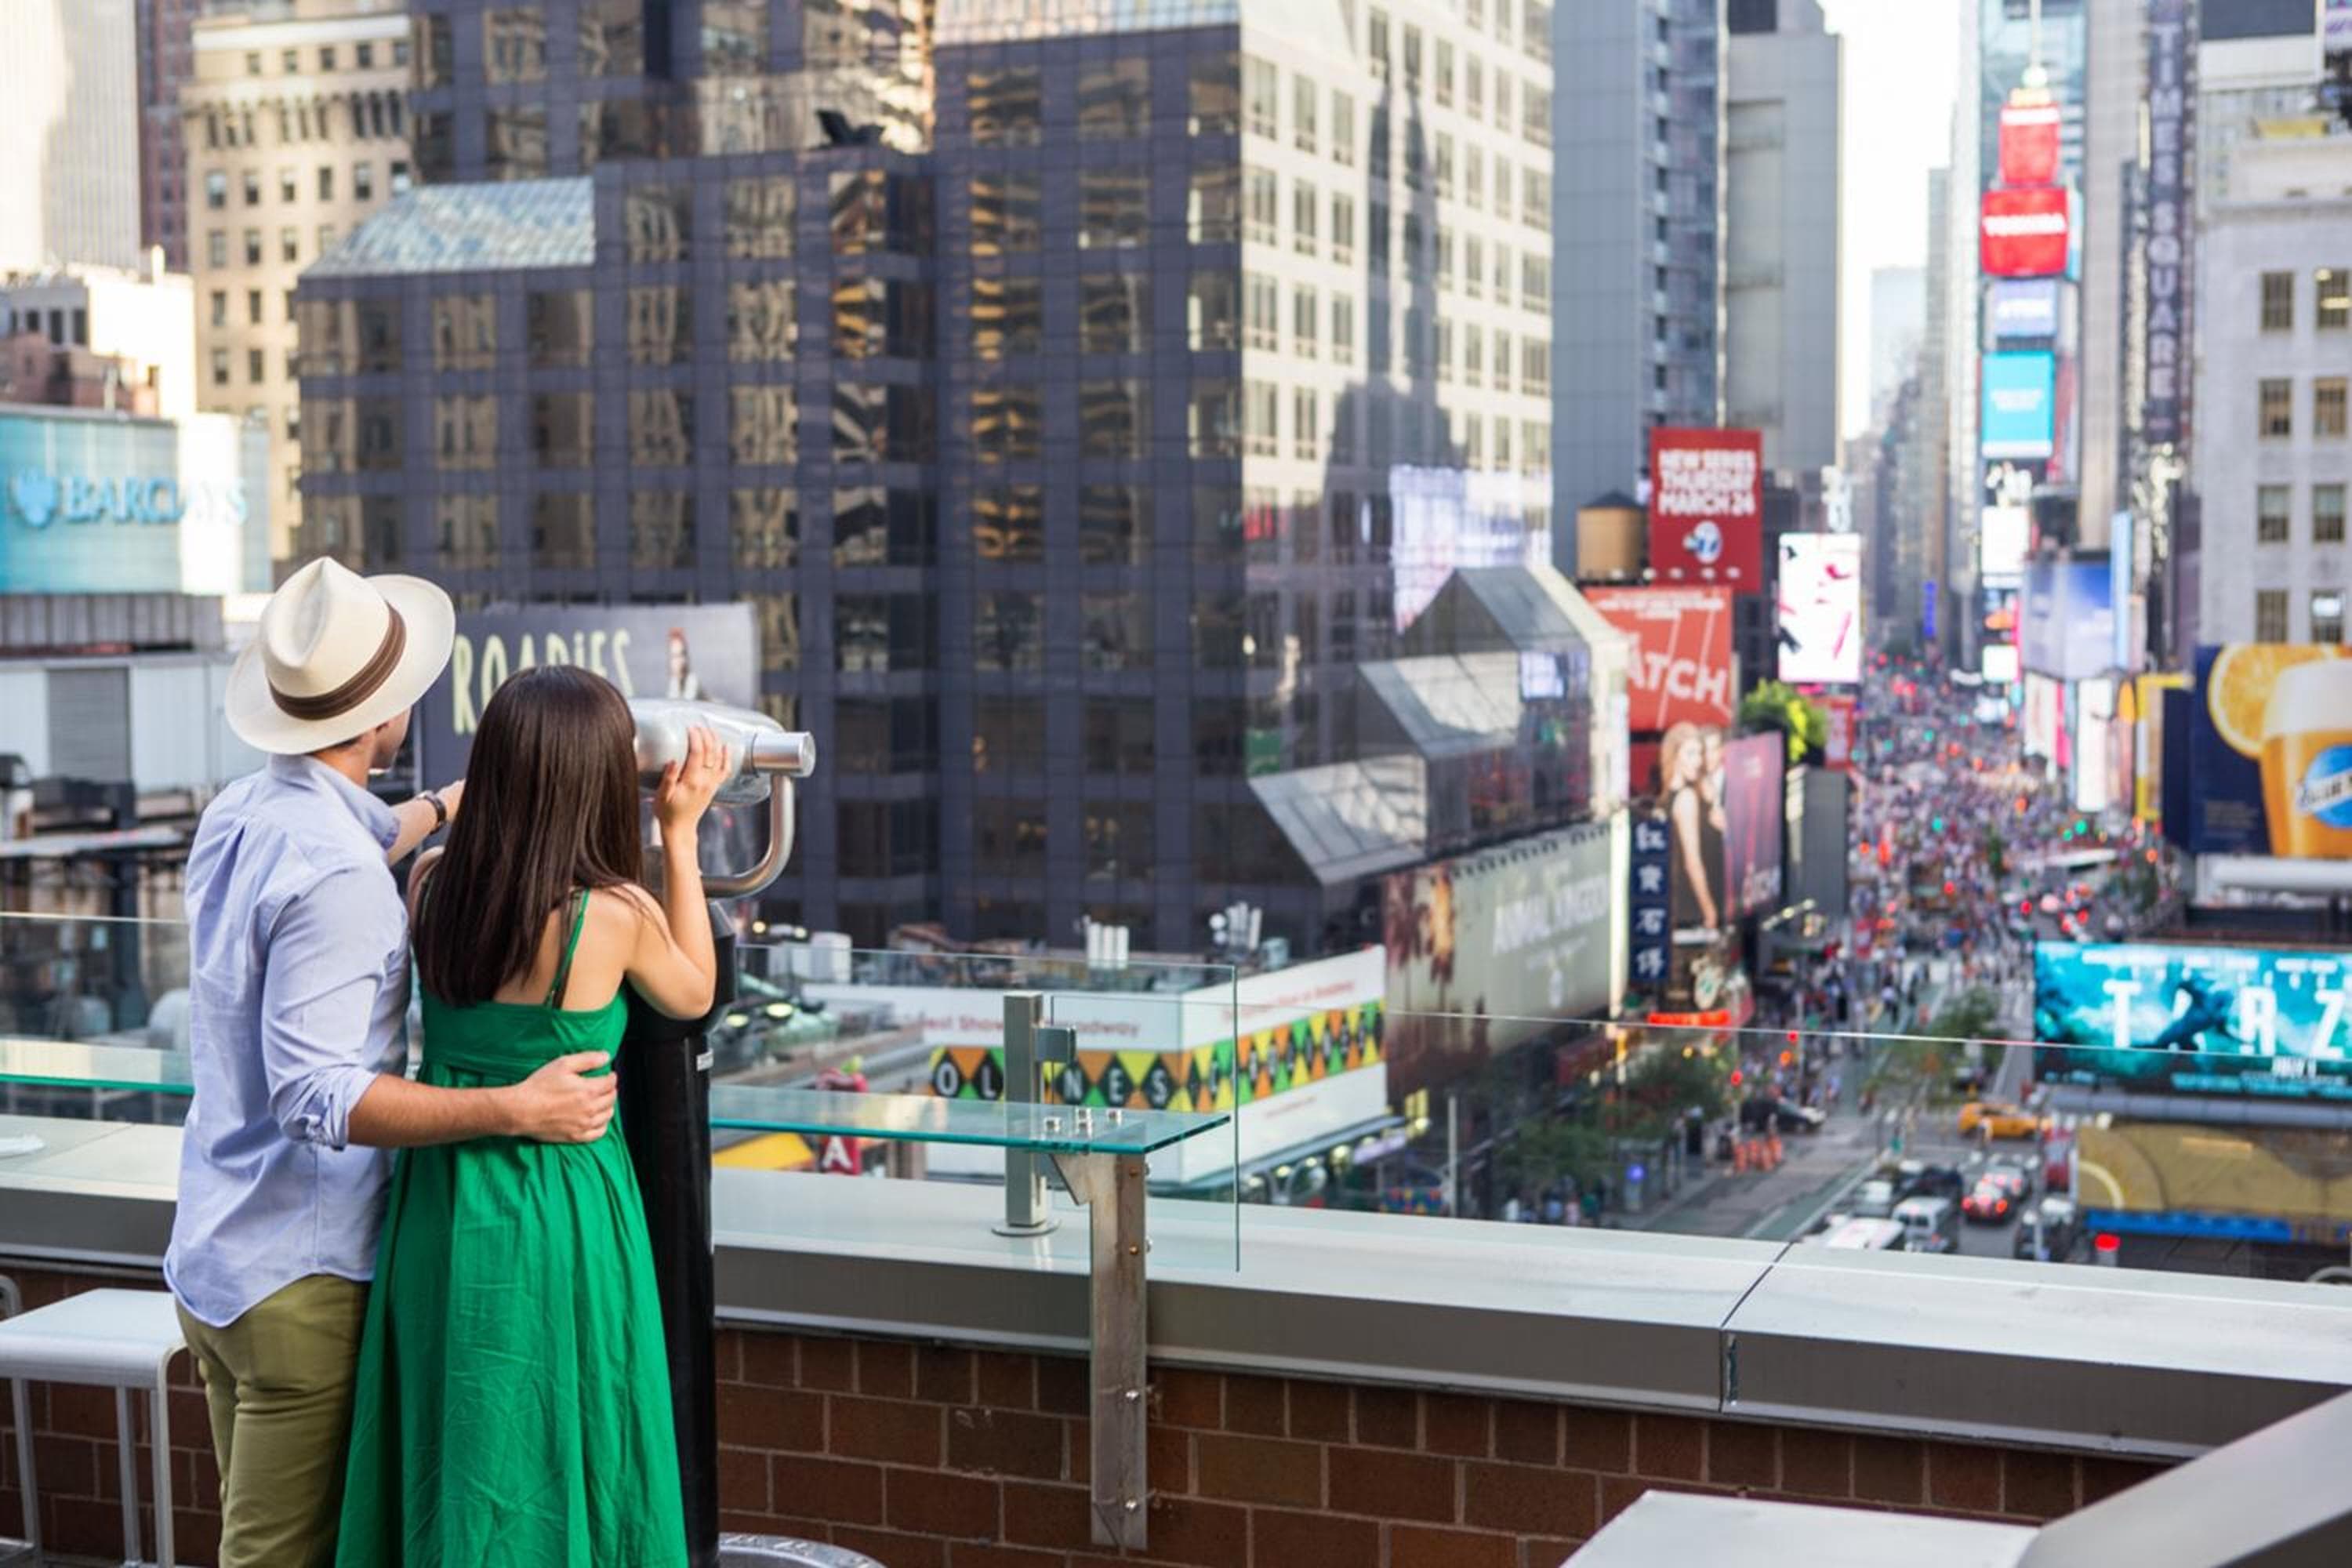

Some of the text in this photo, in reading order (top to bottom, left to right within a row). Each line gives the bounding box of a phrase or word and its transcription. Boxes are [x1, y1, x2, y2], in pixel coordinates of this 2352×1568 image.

[2148, 22, 2182, 398] TIMES SQUARE
[1658, 449, 1700, 470] NEW
[1657, 489, 1729, 516] MARCH
[1628, 632, 1727, 704] ATCH
[936, 1062, 1167, 1105] OLNES
